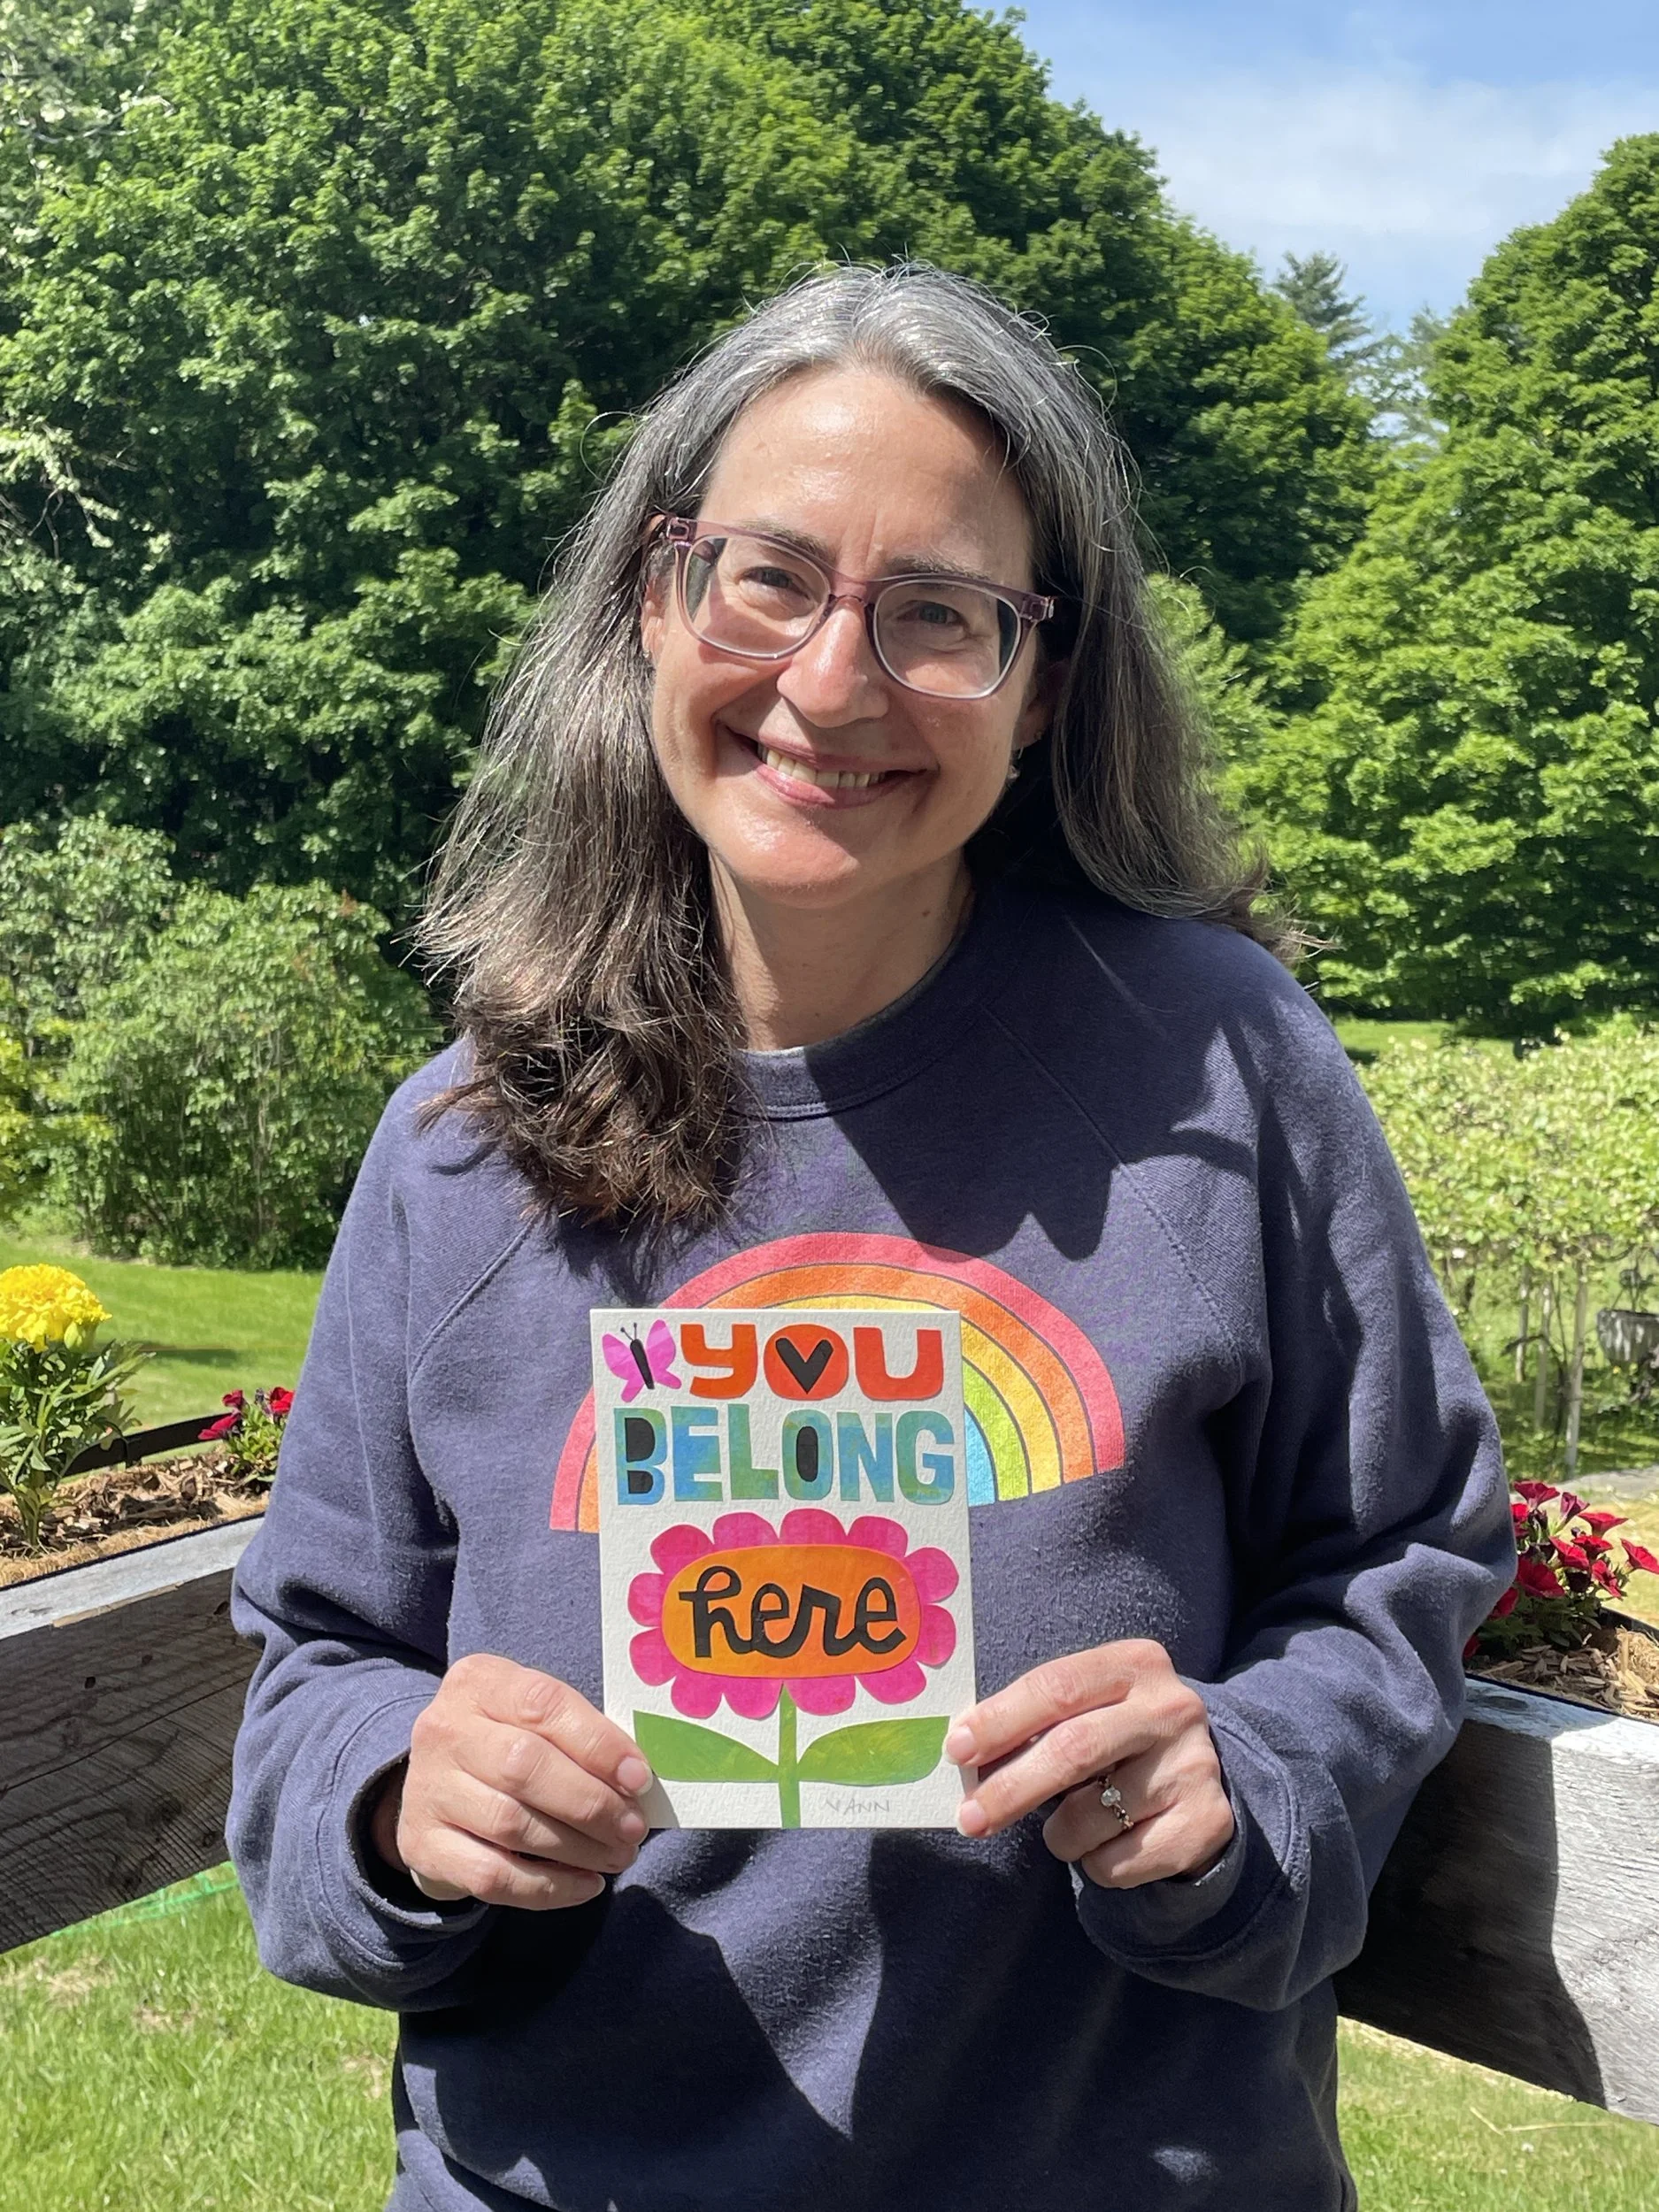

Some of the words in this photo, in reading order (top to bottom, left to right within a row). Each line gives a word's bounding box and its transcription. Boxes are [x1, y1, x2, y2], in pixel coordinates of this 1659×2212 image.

[680, 1324, 944, 1401] YOU
[614, 1403, 955, 1504] BELONG
[679, 1565, 907, 1658] here
